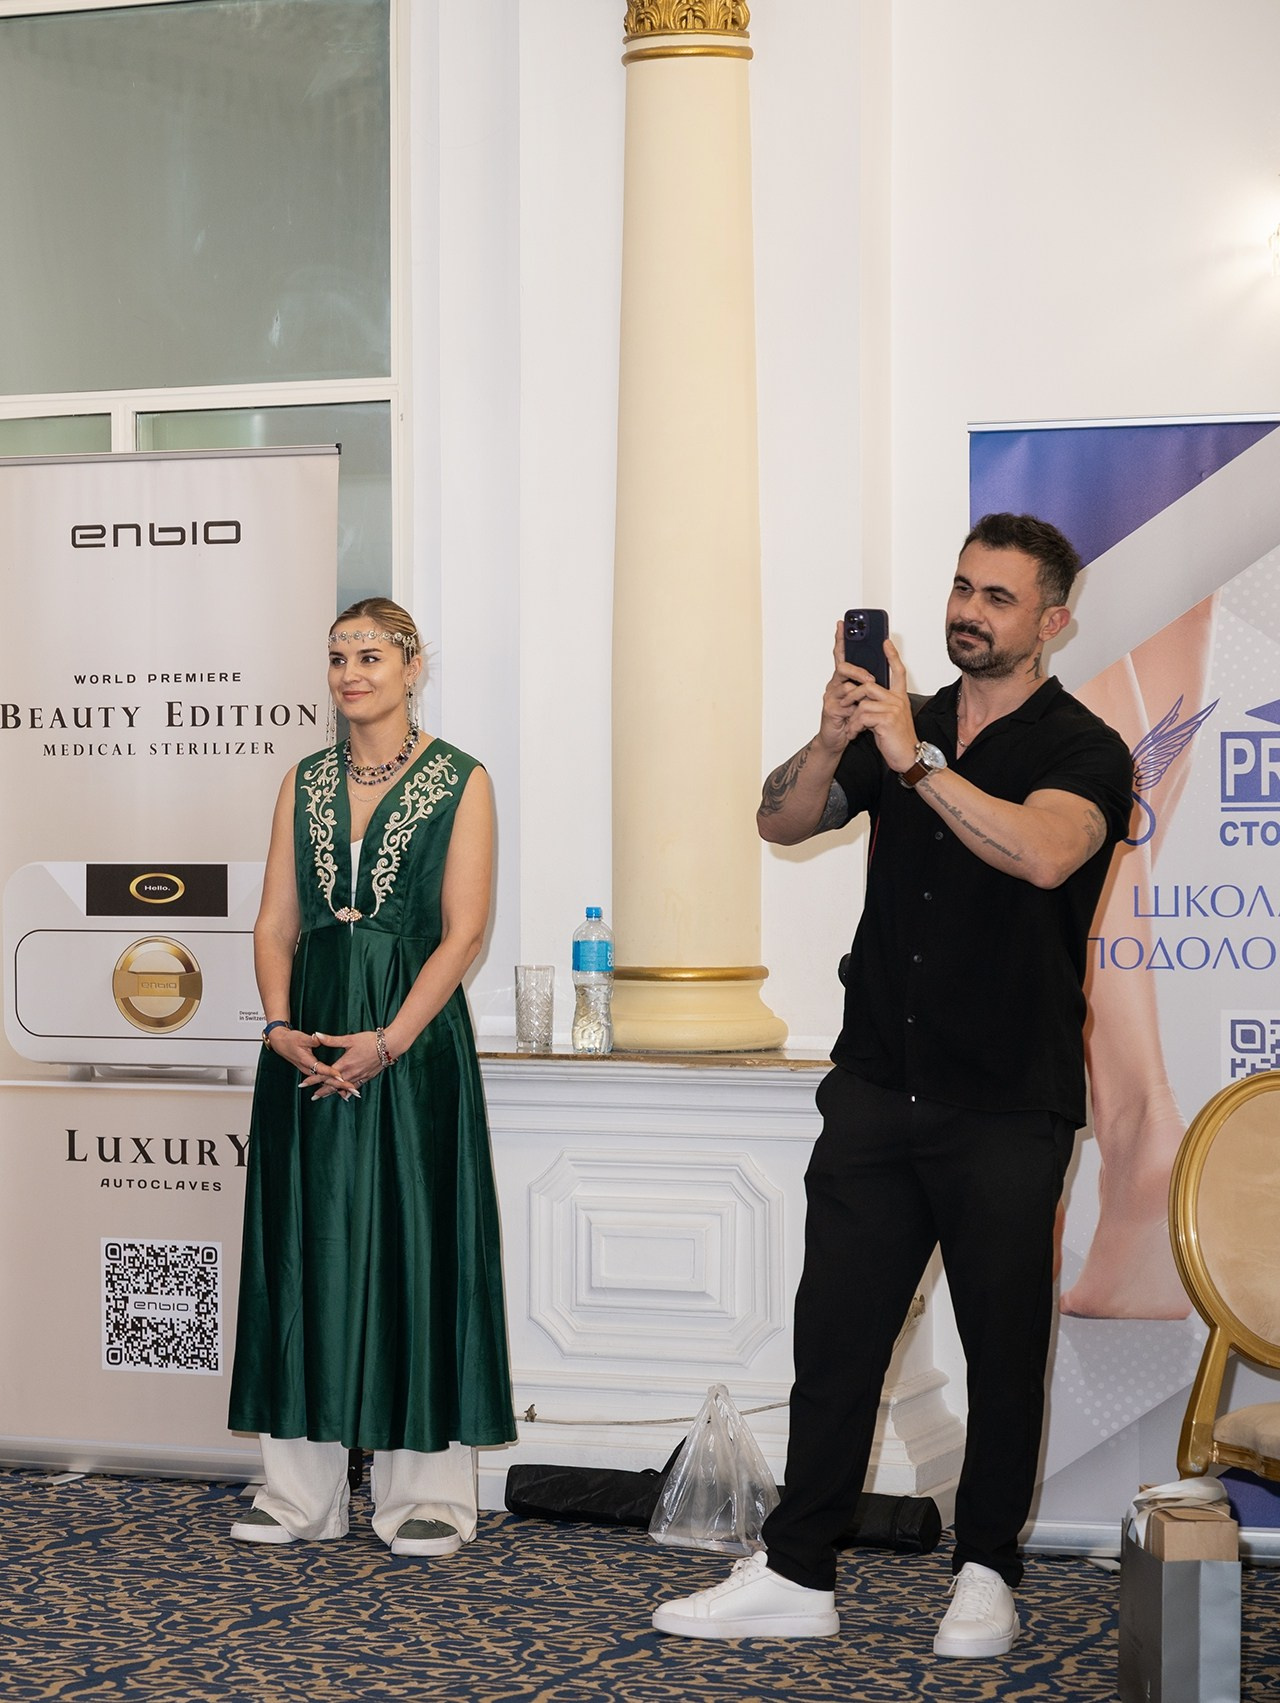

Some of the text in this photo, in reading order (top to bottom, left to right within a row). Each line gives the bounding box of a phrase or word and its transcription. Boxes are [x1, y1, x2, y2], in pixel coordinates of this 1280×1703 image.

[74, 672, 242, 685] WORLD PREMIERE
[42, 741, 276, 757] MEDICAL STERILIZER
[1133, 884, 1280, 918] ШКОЛ
[100, 1178, 223, 1192] AUTOCLAVES
